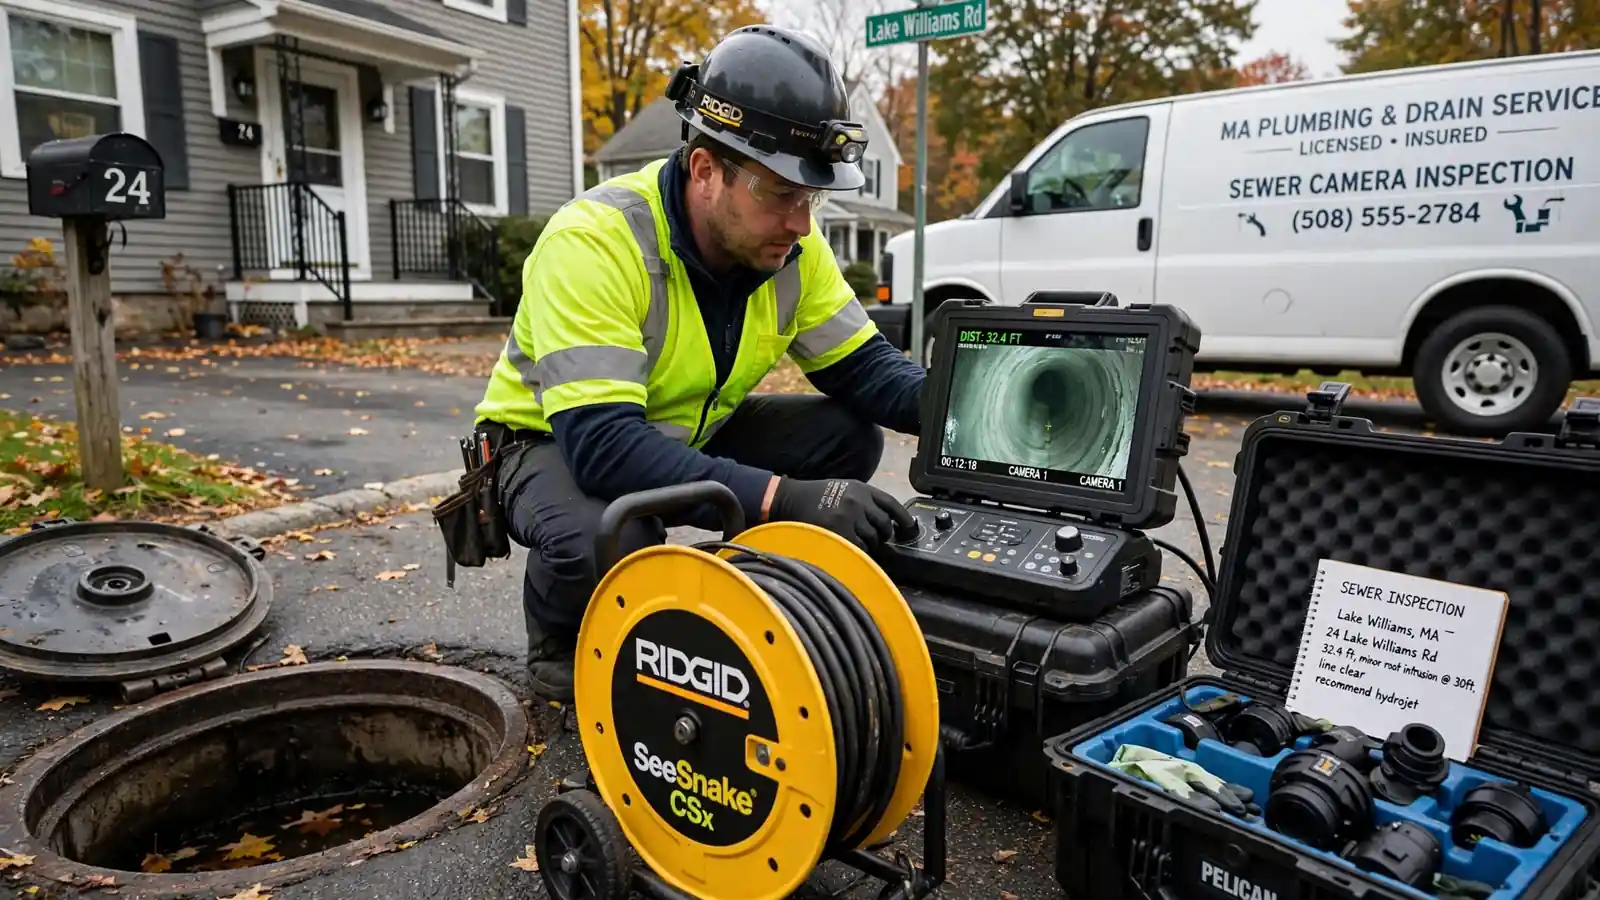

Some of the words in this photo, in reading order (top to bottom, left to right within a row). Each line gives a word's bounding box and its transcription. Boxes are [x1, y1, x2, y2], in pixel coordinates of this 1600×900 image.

[868, 18, 899, 42] Lake
[904, 10, 960, 37] Williams
[964, 4, 982, 28] Rd
[701, 94, 744, 122] RIDGID
[1220, 121, 1251, 140] MA
[1258, 107, 1373, 138] PLUMBING
[1381, 105, 1397, 125] &
[1405, 97, 1483, 123] DRAIN
[238, 124, 254, 141] 24
[1299, 135, 1382, 156] LICENSED
[1404, 126, 1488, 147] INSURED
[104, 167, 151, 205] 24
[1229, 176, 1302, 199] SEWER
[1309, 169, 1406, 195] CAMERA
[1415, 157, 1574, 188] INSPECTION
[1292, 208, 1353, 234] (508)
[1361, 202, 1481, 228] 555-2784
[960, 330, 984, 342] DIST:
[986, 332, 1006, 344] 32.4
[1009, 333, 1022, 344] FT
[941, 456, 977, 470] 00:12:18
[1008, 466, 1040, 480] CAMERA
[1043, 470, 1048, 481] 1
[1080, 475, 1115, 490] CAMERA
[1118, 480, 1122, 491] 1
[1340, 581, 1383, 602] SEWER
[1386, 590, 1466, 618] INSPECTION
[1337, 608, 1362, 624] Lake
[1368, 615, 1415, 639] Williams,
[1419, 627, 1439, 642] MA
[1326, 626, 1340, 639] 24
[1343, 630, 1368, 646] Lake
[1372, 637, 1417, 659] Williams
[1422, 648, 1438, 663] Rd
[1318, 658, 1336, 672] line
[1340, 666, 1366, 680] clear
[1322, 644, 1342, 657] 32.4
[1346, 648, 1357, 662] ft,
[1359, 654, 1381, 667] minor
[1384, 660, 1401, 672] root
[1440, 674, 1451, 686] @
[1315, 675, 1372, 698] recommend
[1376, 688, 1420, 710] hydrojet
[670, 790, 714, 831] CSx
